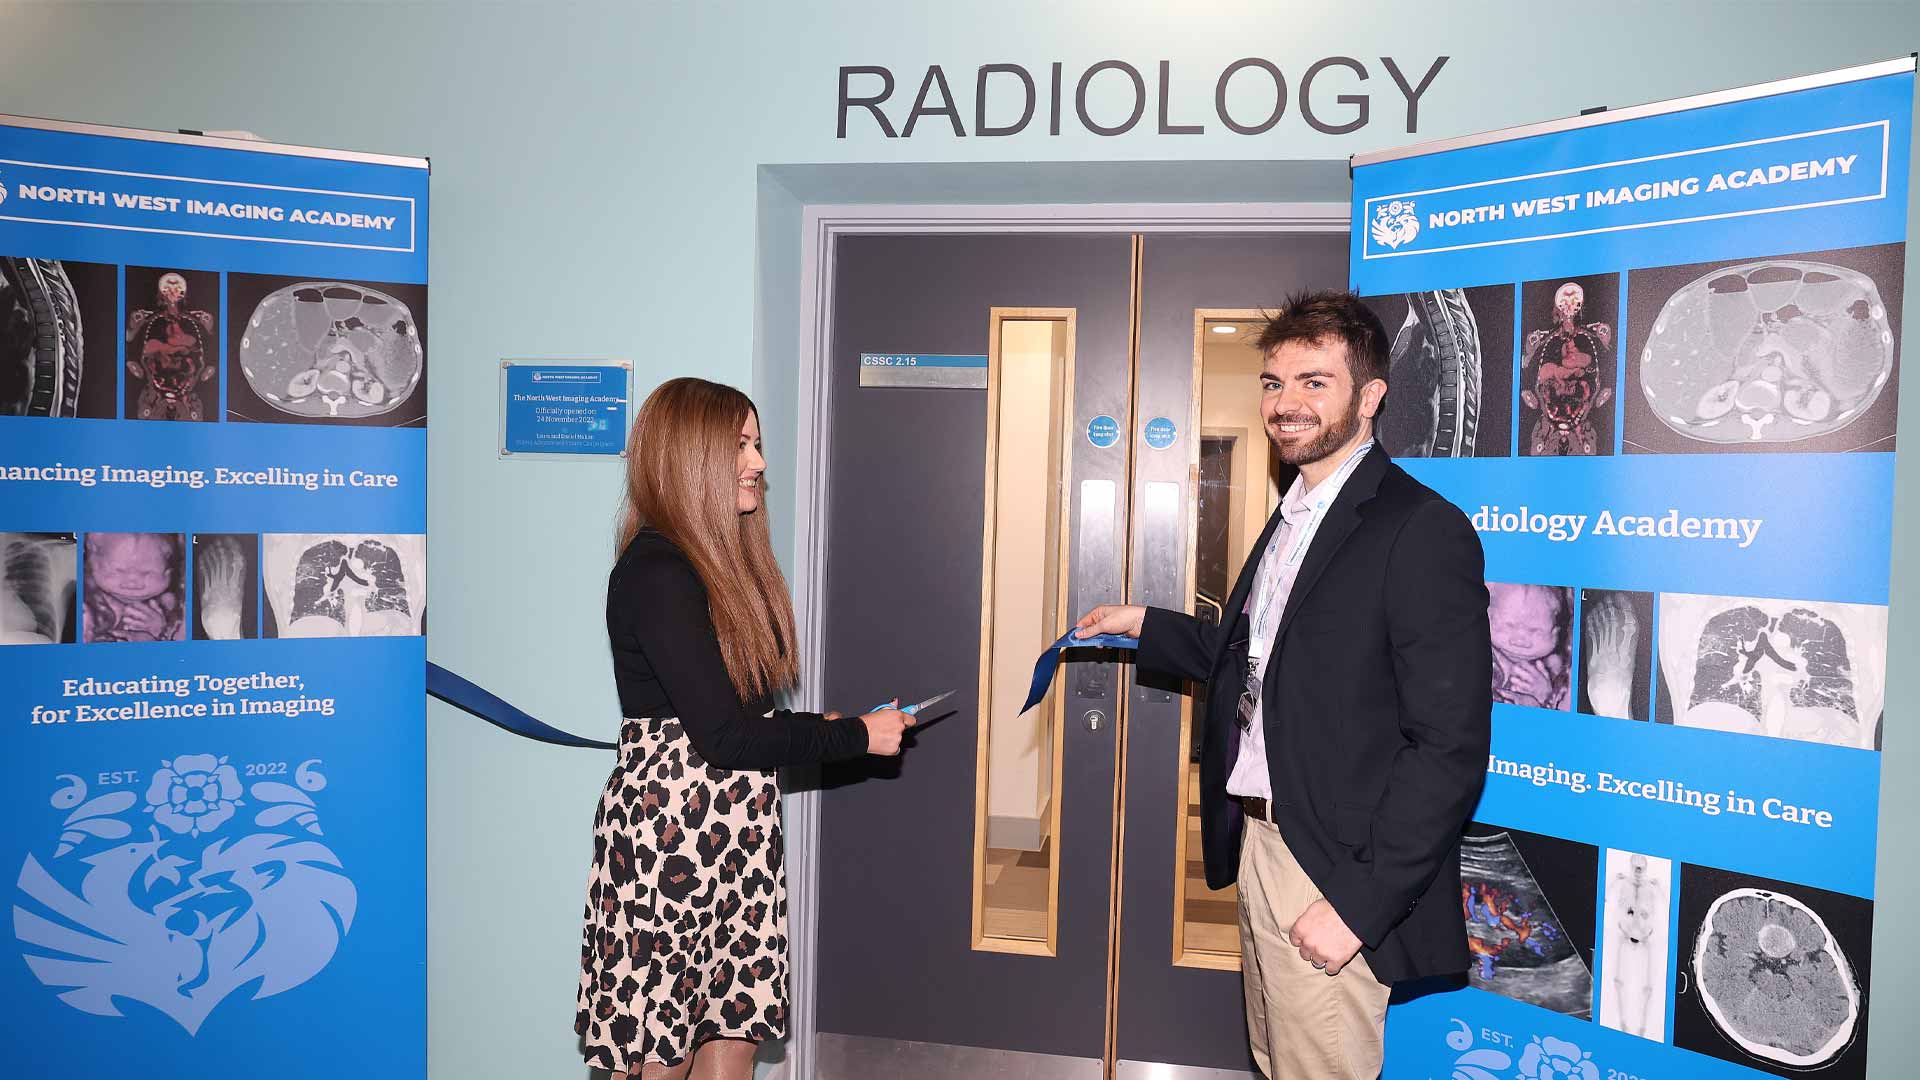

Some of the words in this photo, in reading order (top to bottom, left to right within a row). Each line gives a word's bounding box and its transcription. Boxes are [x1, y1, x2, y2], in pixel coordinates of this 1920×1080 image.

[836, 56, 1450, 138] RADIOLOGY
[1428, 203, 1504, 229] NORTH
[1511, 194, 1581, 219] WEST
[1586, 176, 1699, 210] IMAGING
[1705, 154, 1858, 193] ACADEMY
[18, 184, 105, 206] NORTH
[112, 195, 181, 213] WEST
[187, 200, 284, 222] IMAGING
[289, 211, 396, 230] ACADEMY
[863, 356, 893, 366] CSSC
[895, 357, 917, 366] 2.15
[562, 395, 589, 403] Imaging
[589, 395, 618, 404] Academy
[563, 407, 587, 416] opened
[544, 415, 578, 423] November
[101, 465, 210, 488] Imaging.
[214, 467, 318, 490] Excelling
[322, 468, 345, 486] in
[350, 470, 399, 487] Care
[1591, 509, 1763, 548] Academy
[62, 675, 190, 697] Educating
[194, 671, 305, 695] Together,
[31, 705, 75, 724] for
[75, 700, 207, 723] Excellence
[211, 698, 236, 716] in
[239, 695, 335, 717] Imaging
[98, 770, 140, 785] EST.
[245, 762, 287, 776] 2022
[1487, 754, 1592, 793] Imaging.
[1596, 772, 1721, 816] Excelling
[1726, 790, 1756, 816] in
[1761, 797, 1833, 828] Care
[1481, 1027, 1514, 1049] EST.
